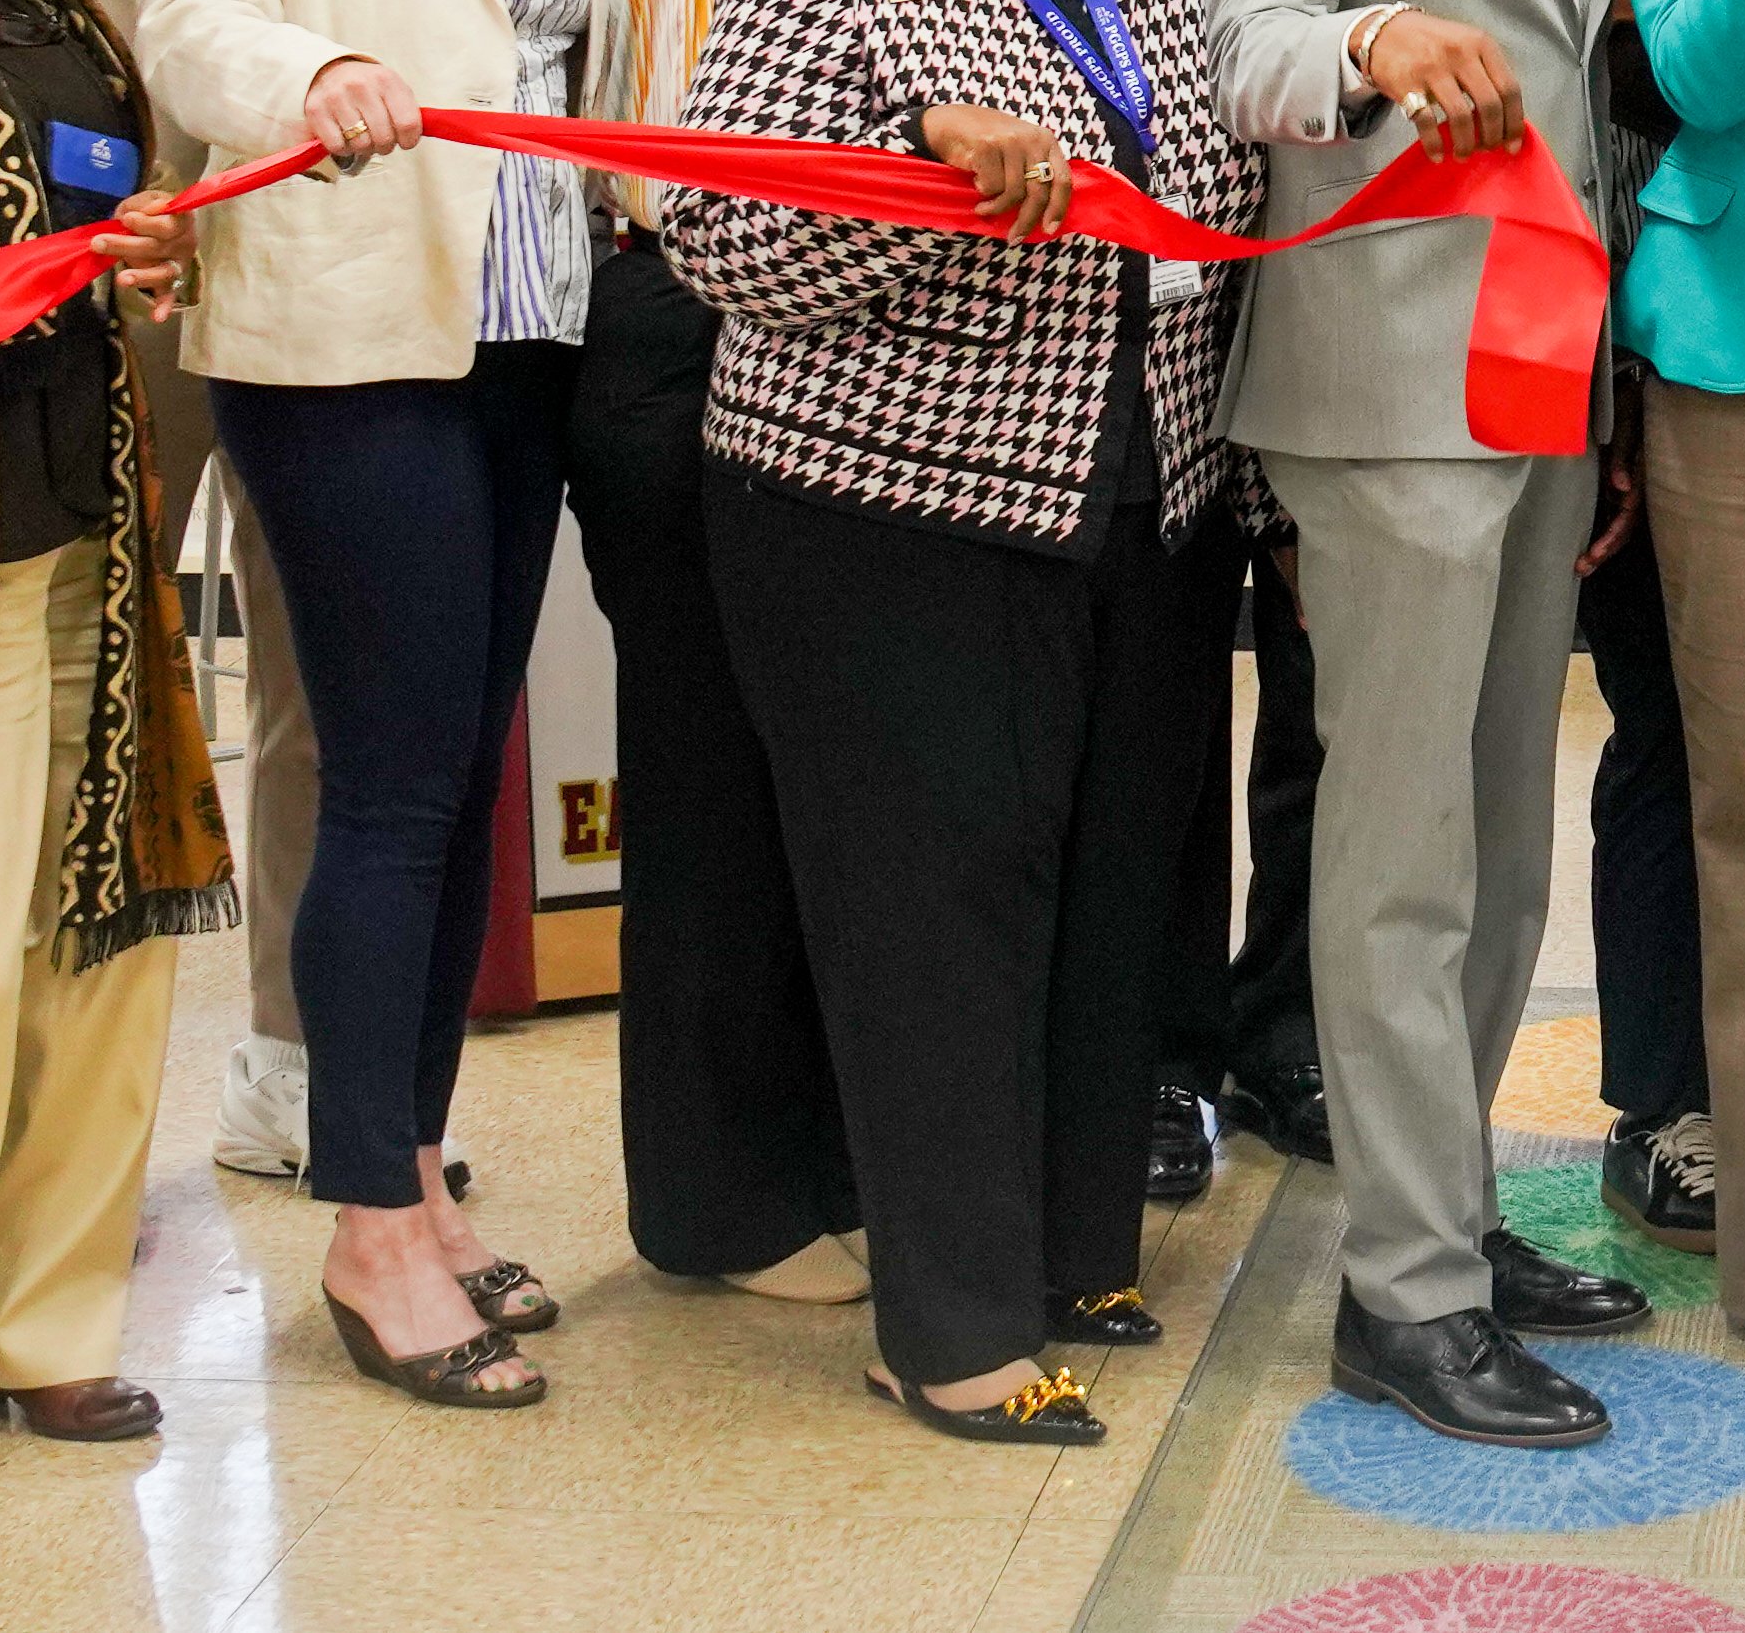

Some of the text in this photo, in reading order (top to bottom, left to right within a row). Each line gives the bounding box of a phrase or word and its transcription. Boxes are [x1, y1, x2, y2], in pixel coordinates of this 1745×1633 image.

[1045, 11, 1089, 57] PROUD
[1084, 56, 1123, 99] PGCPS
[1104, 24, 1132, 69] PGCPS
[1122, 69, 1148, 120] PROUD
